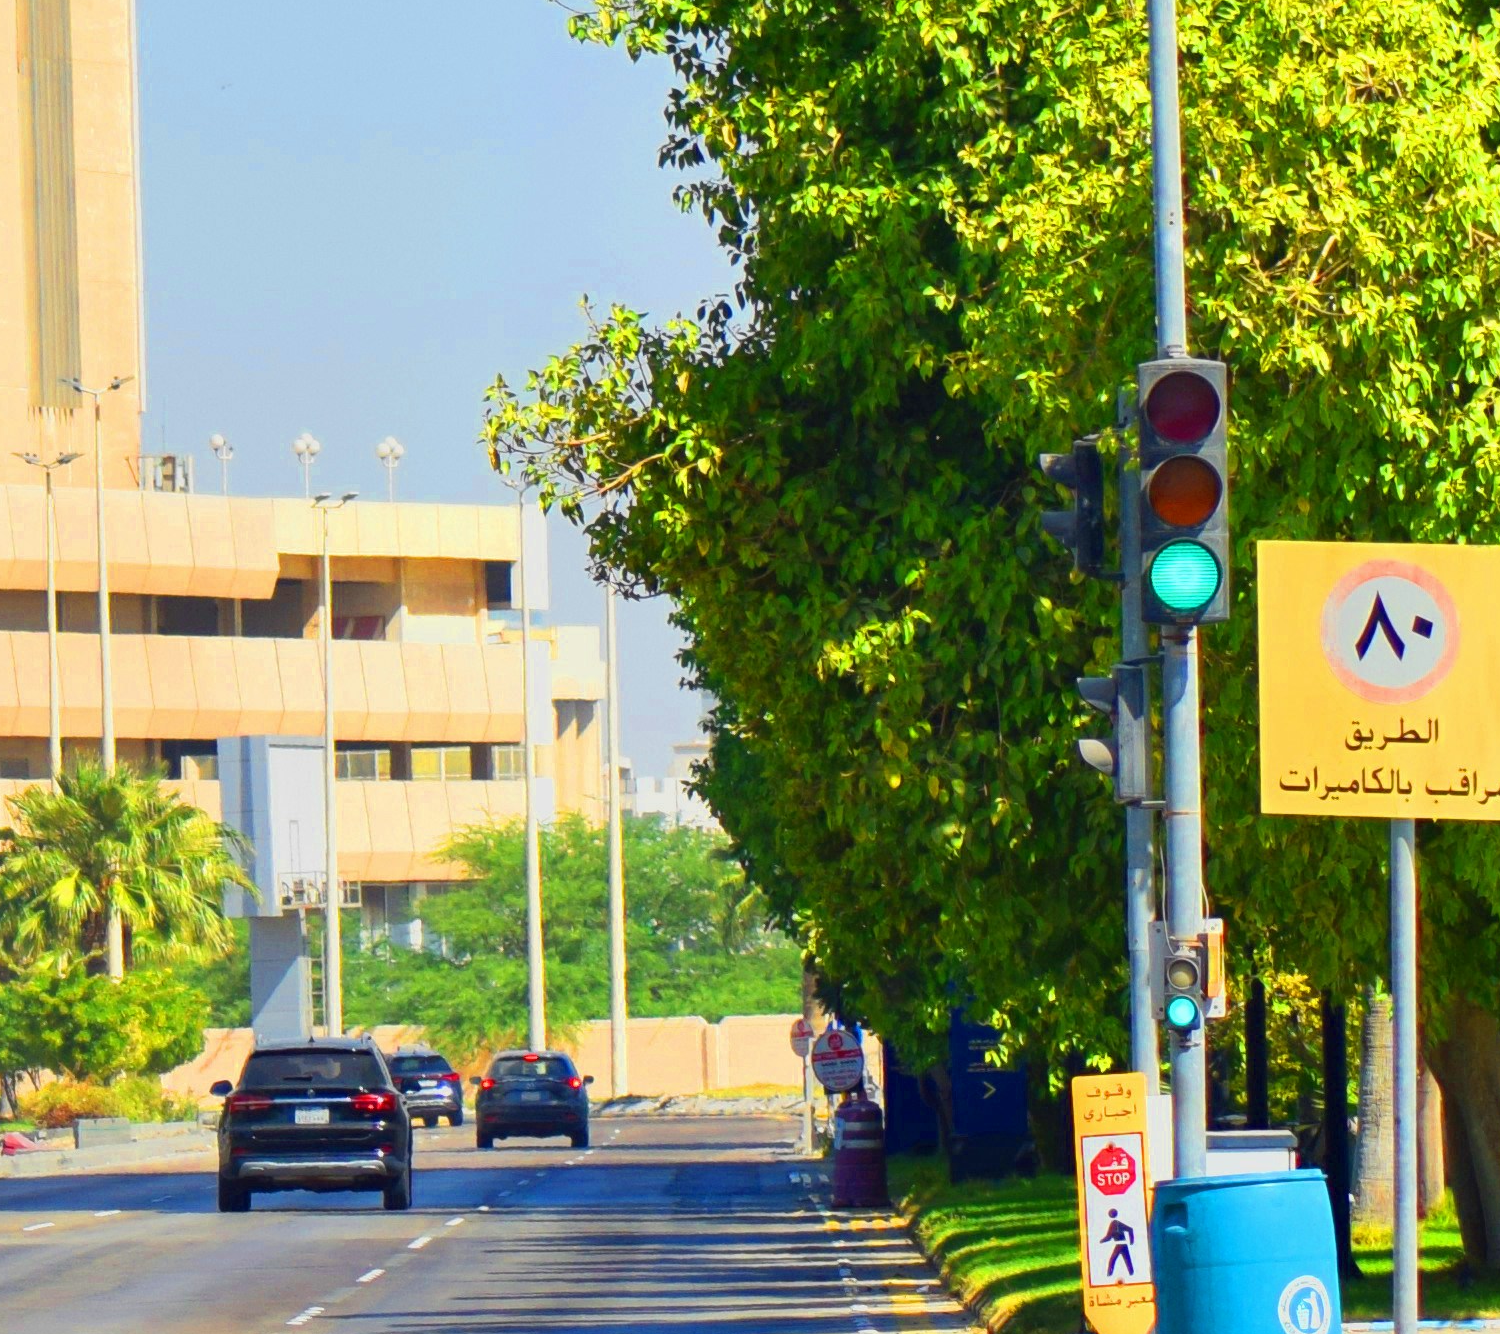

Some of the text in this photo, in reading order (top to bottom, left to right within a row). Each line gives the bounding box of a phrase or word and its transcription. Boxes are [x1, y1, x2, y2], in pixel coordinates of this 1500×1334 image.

[1355, 590, 1433, 662] ٨٠
[1345, 717, 1439, 751] الطريق
[1280, 765, 1413, 803] بالكاميرات
[1087, 1083, 1132, 1100] وقوف
[1083, 1104, 1137, 1123] اجباري
[1097, 1154, 1129, 1171] قف
[1097, 1172, 1130, 1187] STOP
[1089, 1294, 1122, 1307] مشاة
